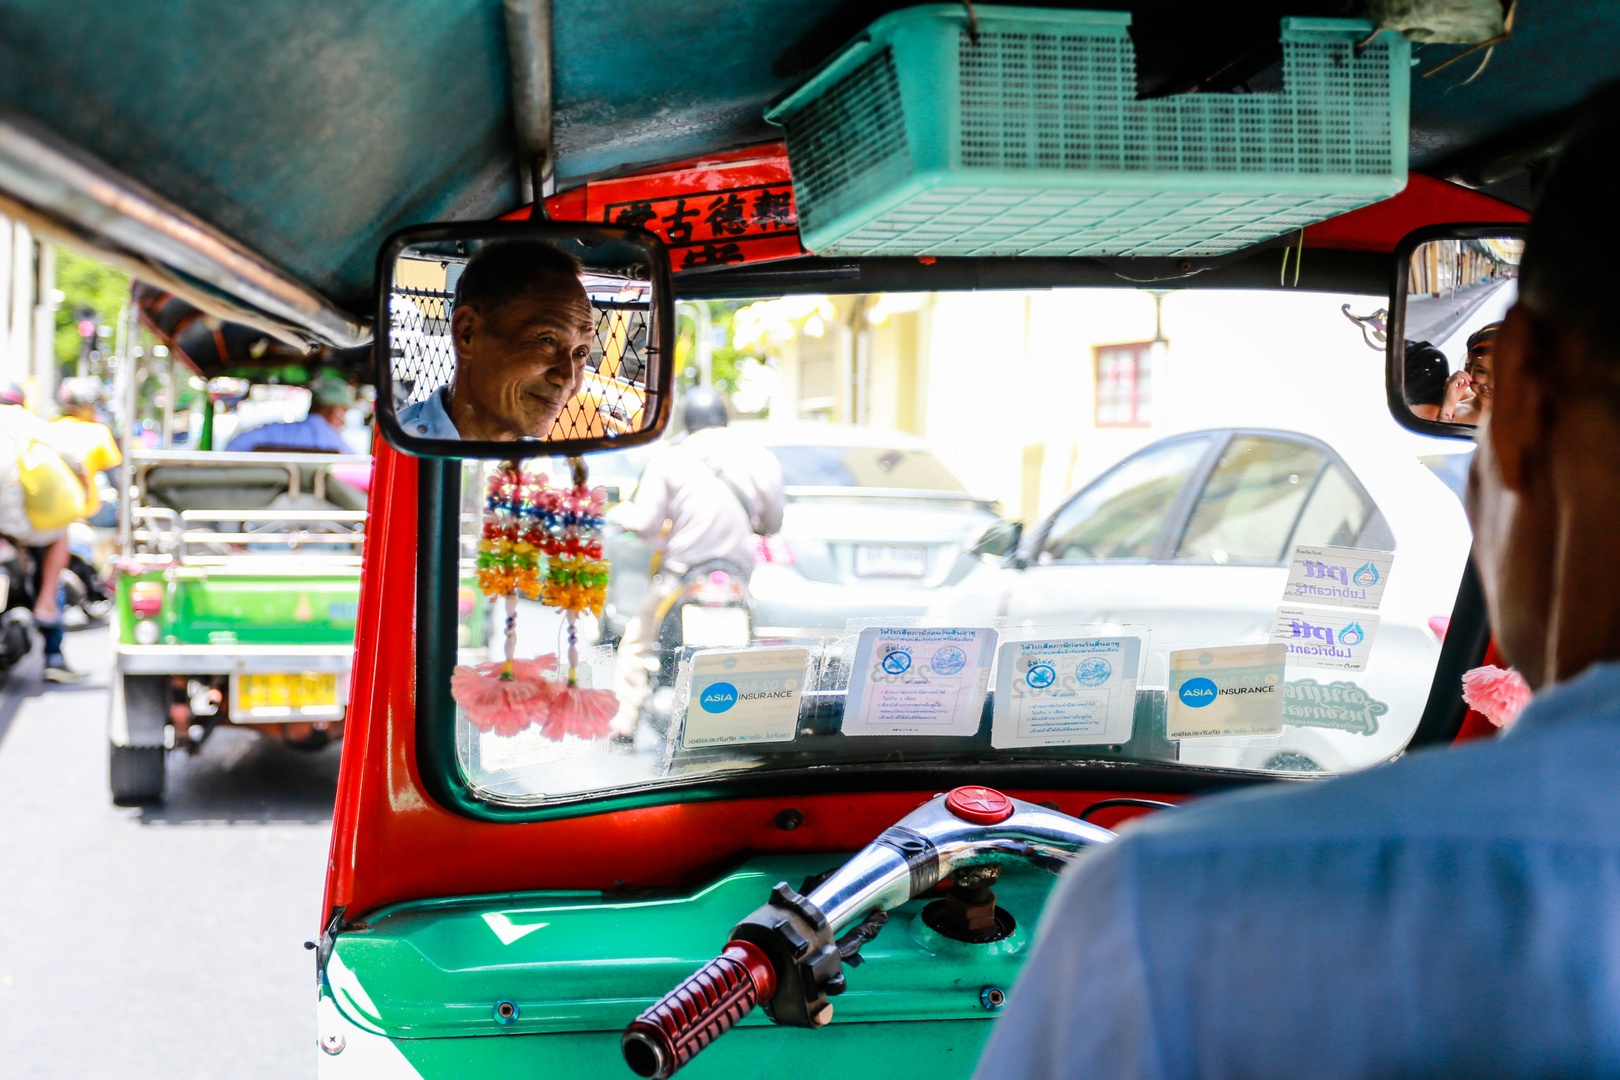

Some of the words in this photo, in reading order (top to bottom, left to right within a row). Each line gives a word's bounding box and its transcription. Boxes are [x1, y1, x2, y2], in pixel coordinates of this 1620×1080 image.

[704, 693, 733, 702] ASIA
[738, 690, 793, 701] INSURANCE
[1183, 689, 1213, 697] ASIA
[1218, 685, 1275, 696] INSURANCE
